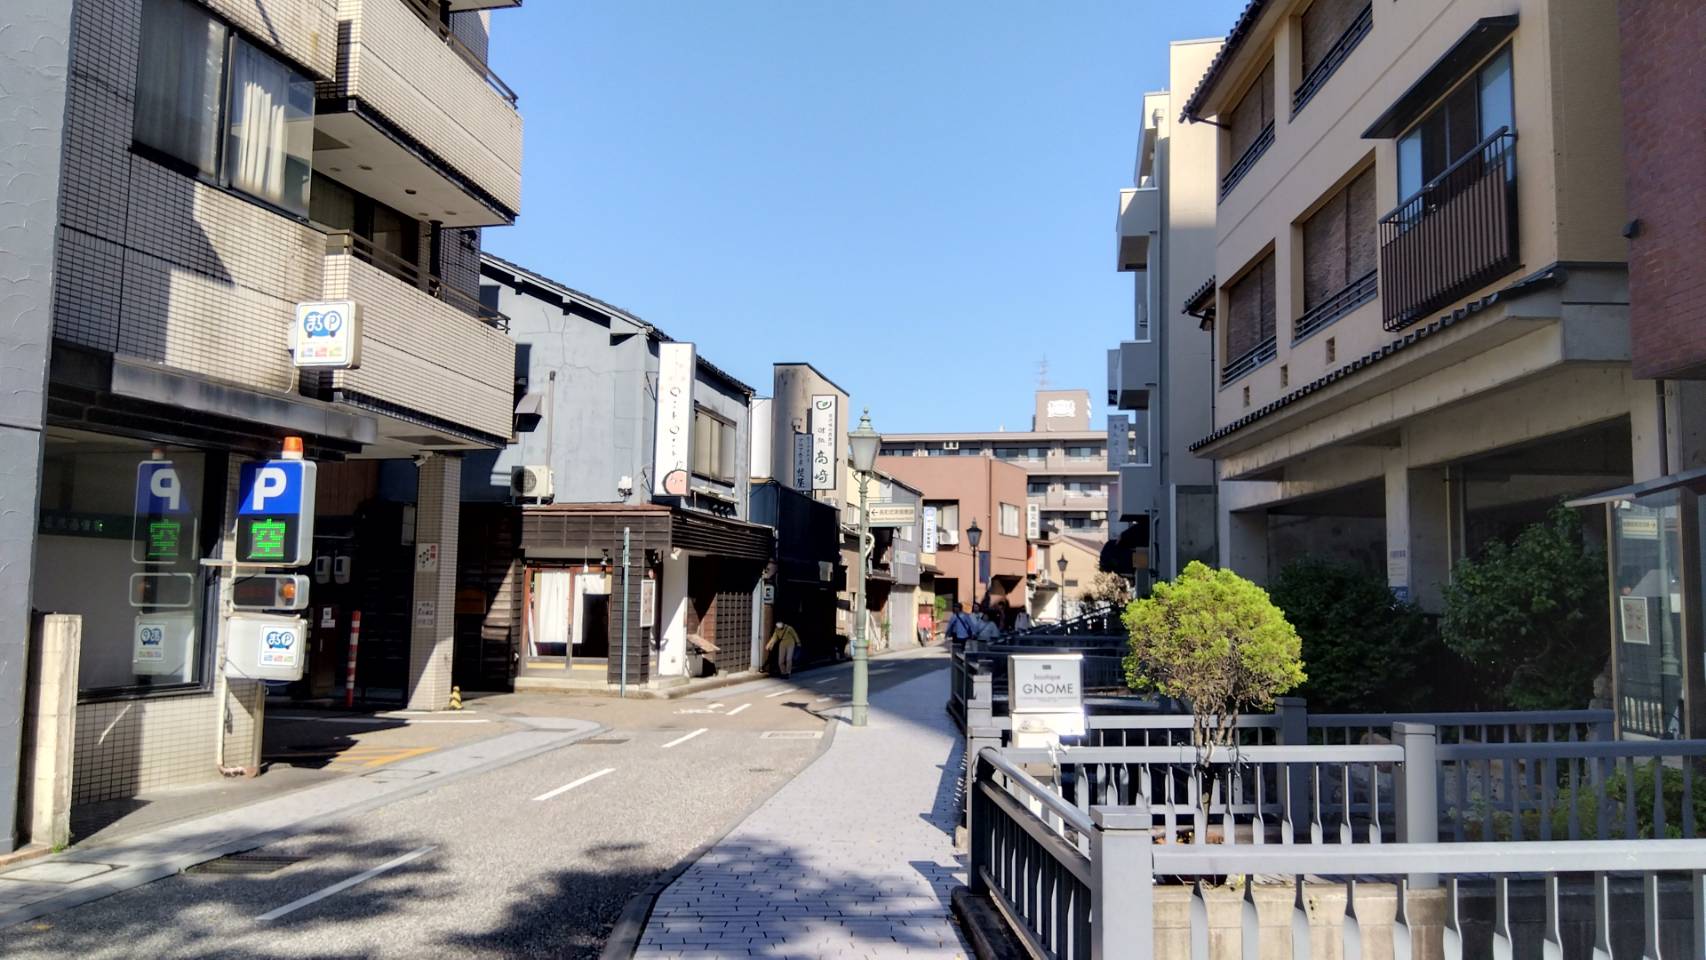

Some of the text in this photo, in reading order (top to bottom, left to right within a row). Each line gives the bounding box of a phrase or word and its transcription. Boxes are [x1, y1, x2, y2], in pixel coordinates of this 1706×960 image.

[252, 467, 287, 511] P
[251, 518, 286, 557] 空
[1022, 683, 1074, 694] GNOME
